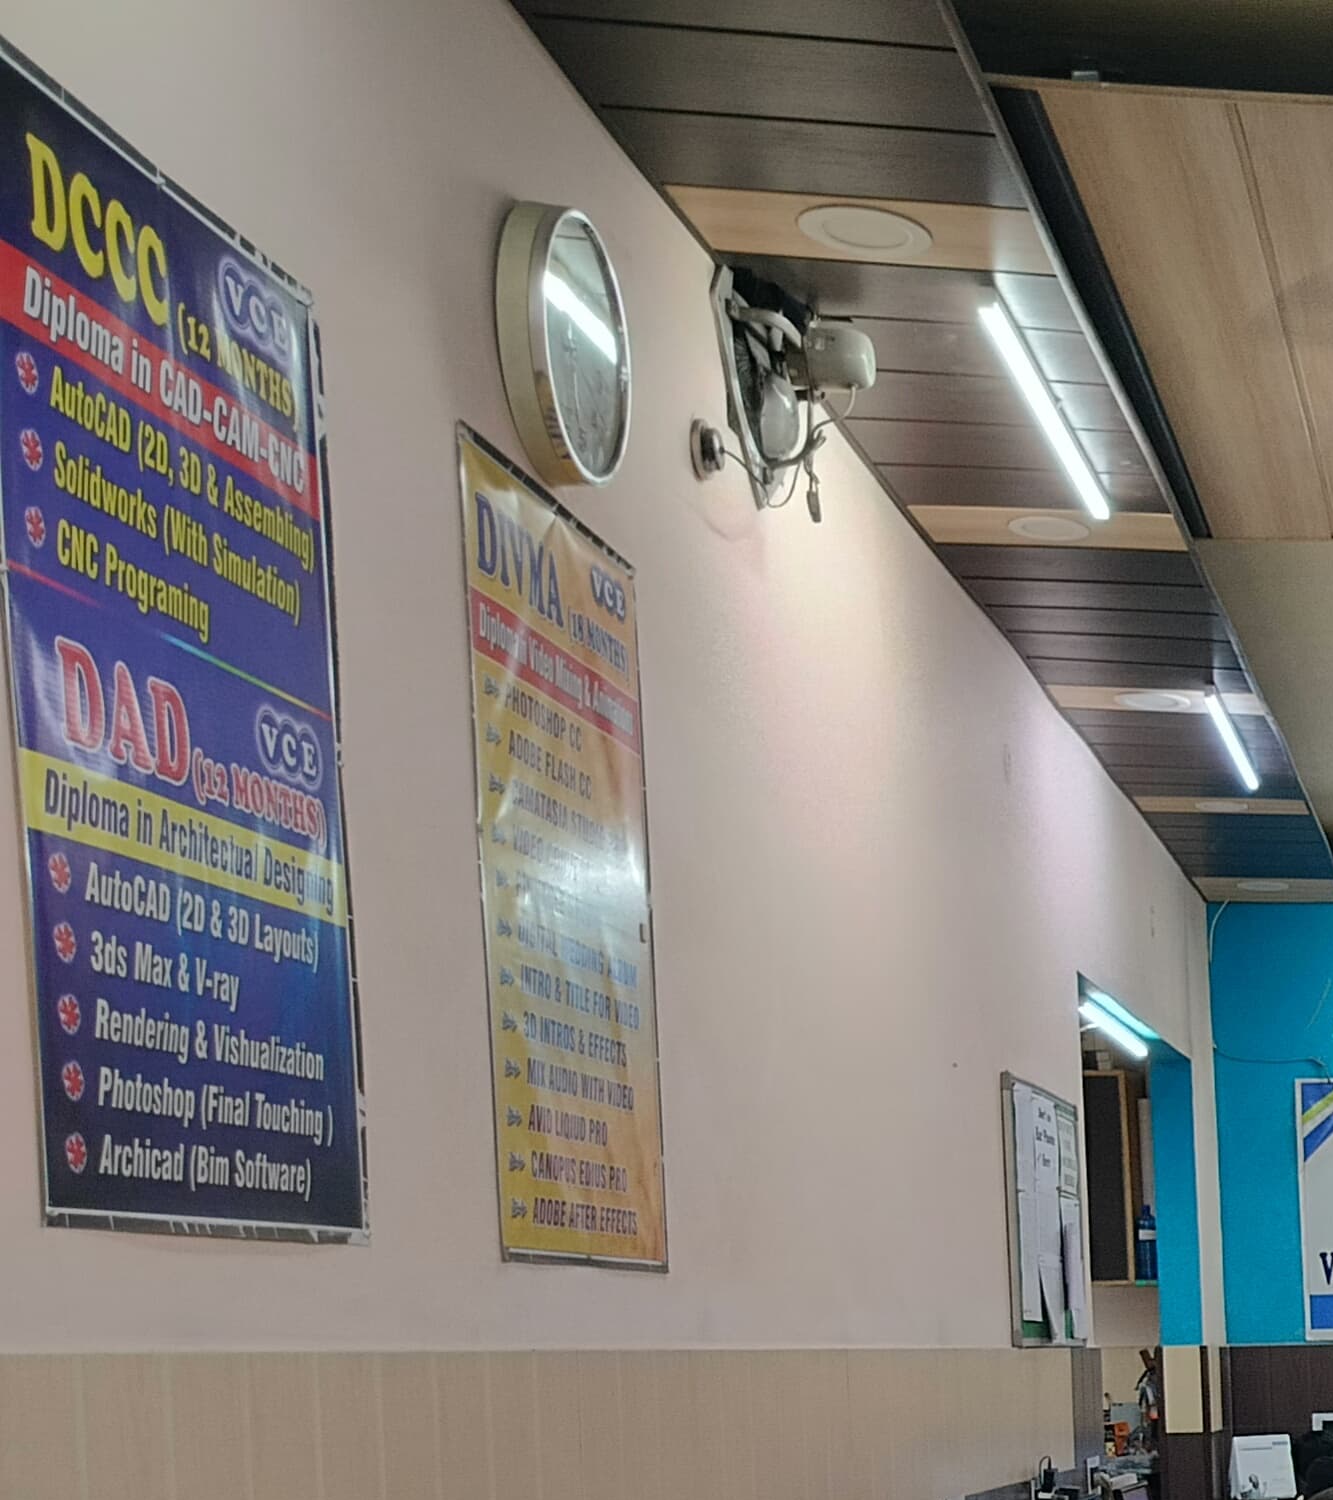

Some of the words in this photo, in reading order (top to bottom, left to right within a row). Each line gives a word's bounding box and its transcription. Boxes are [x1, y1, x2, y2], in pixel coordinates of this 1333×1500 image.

[25, 132, 168, 328] DCCC
[178, 302, 210, 358] (12
[217, 333, 301, 433] MONTHS)
[24, 267, 123, 375] Diploma
[131, 339, 151, 393] in
[160, 365, 306, 494] CAD-CAM-CNC
[50, 366, 131, 454] AutoCAD
[138, 423, 174, 488] (2D,
[180, 449, 201, 497] 3D
[207, 465, 218, 502] &
[223, 472, 314, 574] Assembling)
[54, 441, 156, 539] Solidworks
[164, 498, 208, 568] (With
[213, 538, 300, 626] Simulation)
[475, 492, 564, 631] DIVMA
[56, 518, 98, 579] CNC
[105, 546, 209, 644] Programing
[56, 636, 190, 785] DAD
[194, 748, 229, 805] (12
[232, 764, 327, 848] MONTHS)
[262, 722, 318, 778] VCE
[504, 683, 566, 739] PHOTOSHOP
[569, 722, 582, 753] CC
[45, 768, 129, 837] Diploma
[138, 800, 152, 845] in
[159, 810, 258, 883] Architectual
[263, 842, 333, 914] Designing
[85, 862, 170, 922] AutoCAD
[177, 887, 205, 934] (2D
[210, 901, 221, 934] &
[228, 905, 249, 947] 3D
[255, 914, 318, 972] Layouts)
[91, 931, 127, 978] 3ds
[134, 942, 172, 988] Max
[177, 961, 189, 992] &
[196, 959, 240, 1011] V-ray
[95, 999, 190, 1064] Rendering
[195, 1021, 208, 1058] &
[214, 1024, 323, 1081] Vishualization
[523, 1011, 536, 1042] 3D
[540, 1025, 575, 1053] INTROS
[588, 1035, 626, 1067] EFFECTS
[98, 1067, 194, 1127] Photoshop
[201, 1085, 249, 1129] (Final
[528, 1104, 551, 1132] AVID
[589, 1119, 608, 1146] PRO
[99, 1134, 184, 1181] Archicad
[190, 1145, 229, 1191] (Bim
[235, 1150, 312, 1202] Software)
[531, 1151, 576, 1184] CANOPUS
[609, 1165, 628, 1192] PRO
[533, 1198, 566, 1227] ADOBE
[569, 1202, 597, 1231] AFTER
[600, 1207, 638, 1235] EFFECTS
